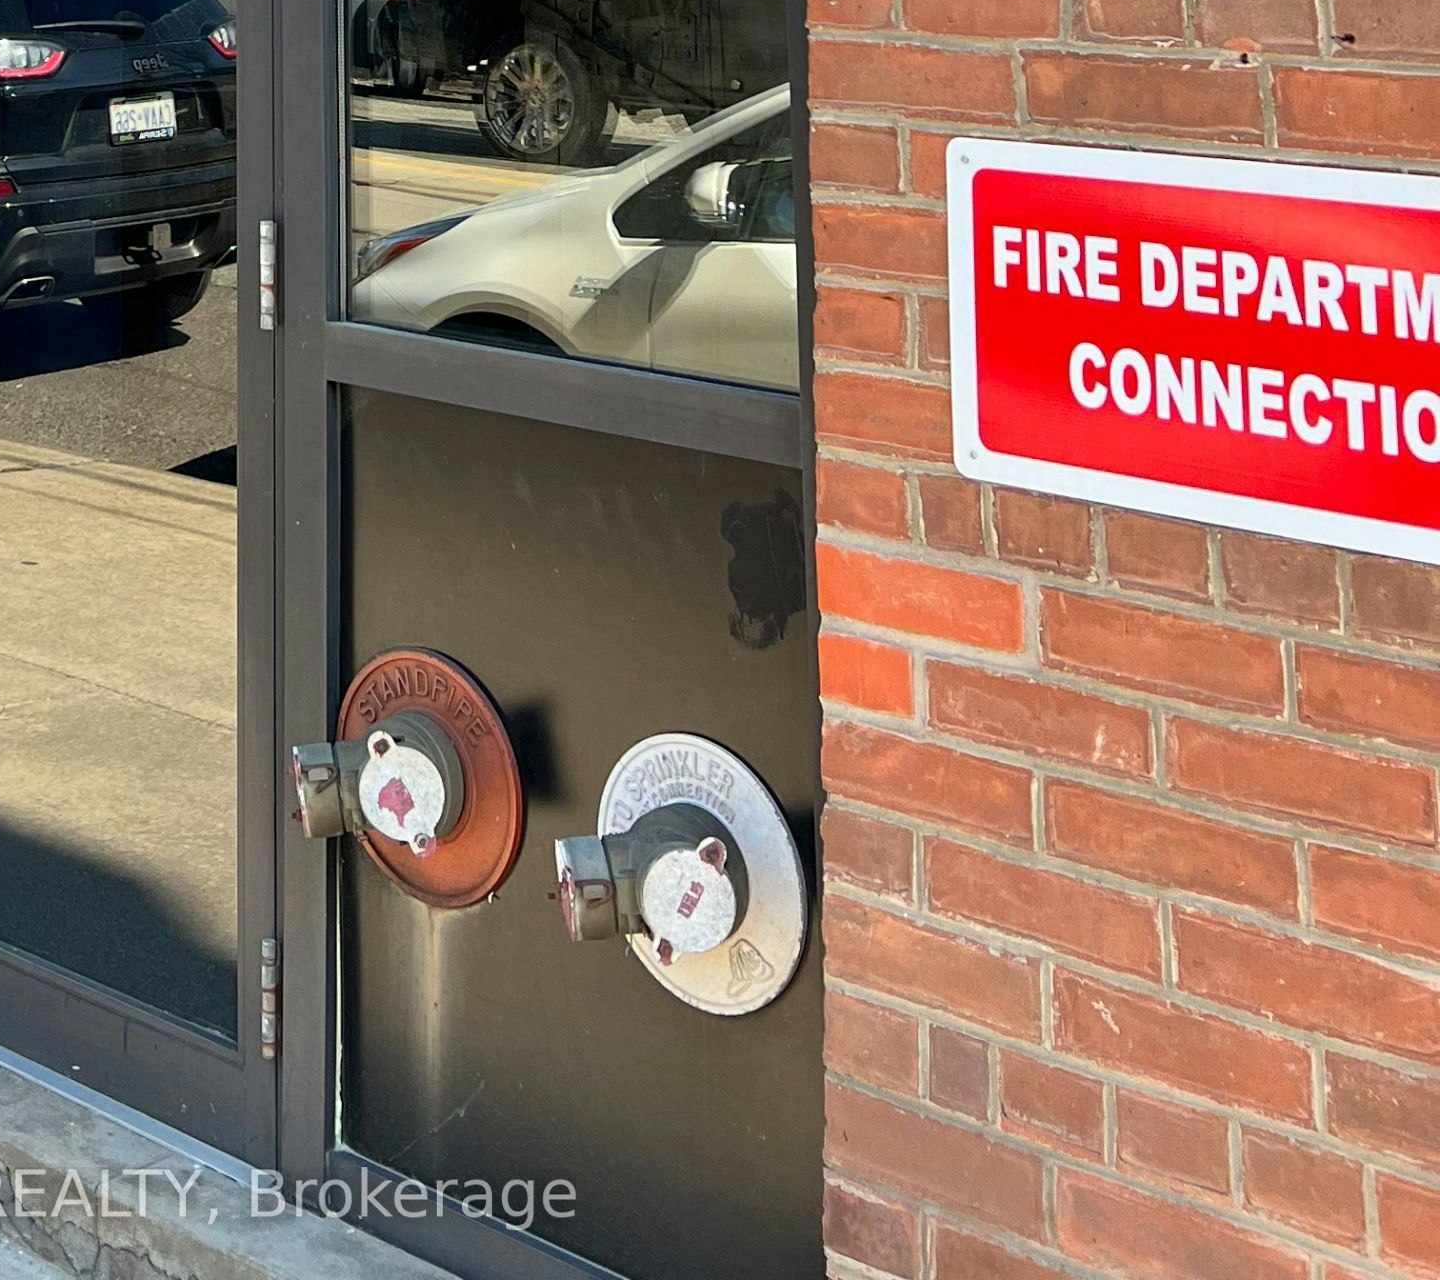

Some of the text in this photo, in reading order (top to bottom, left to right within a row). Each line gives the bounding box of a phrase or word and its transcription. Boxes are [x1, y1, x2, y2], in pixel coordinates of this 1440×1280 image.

[992, 225, 1120, 302] FIRE
[358, 665, 493, 749] STANDPIPE
[625, 750, 735, 802] SPRINKLER
[652, 781, 737, 825] CONNECTION
